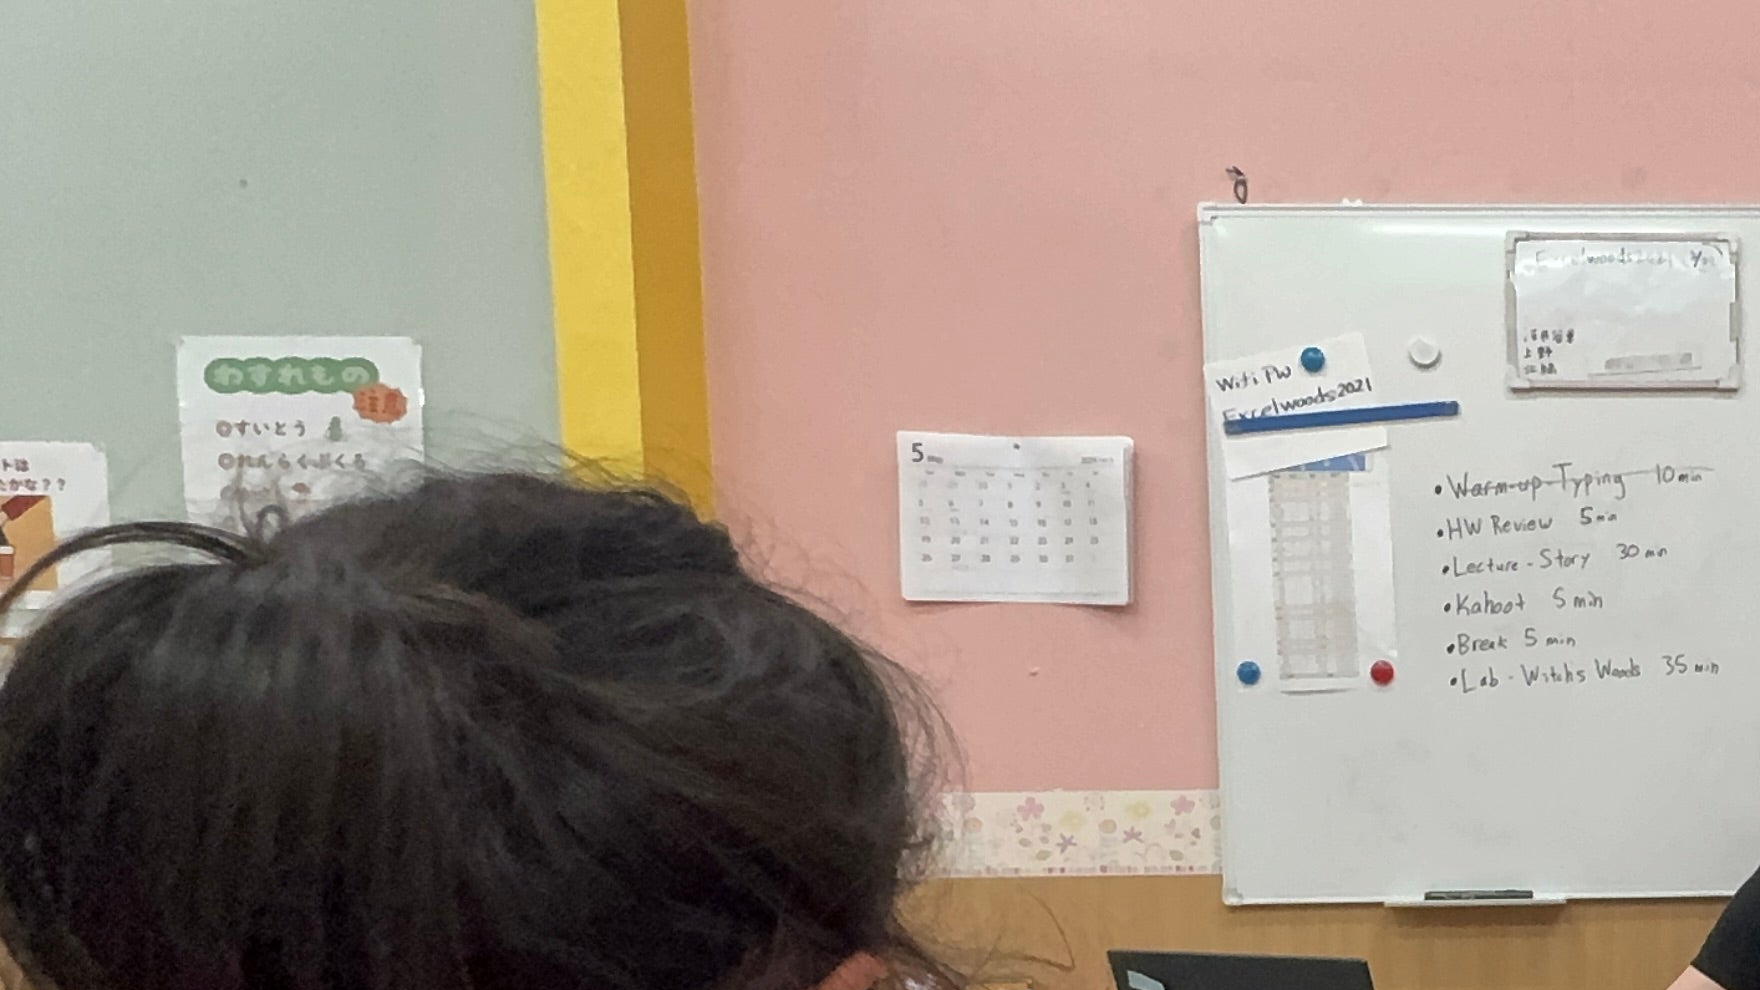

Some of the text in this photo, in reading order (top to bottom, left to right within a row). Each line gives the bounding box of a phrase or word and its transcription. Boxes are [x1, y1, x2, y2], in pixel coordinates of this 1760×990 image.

[213, 362, 371, 386] わすれもの
[235, 419, 306, 437] すいとう
[911, 443, 925, 463] 5
[1447, 472, 1542, 501] Warm-up
[1551, 462, 1627, 500] Typing
[1447, 517, 1482, 540] HW
[1490, 514, 1553, 535] Review
[1453, 555, 1518, 577] Lecture
[1540, 548, 1591, 569] Story
[1456, 591, 1526, 616] Kahoot
[1457, 633, 1508, 655] Break
[1461, 667, 1499, 694] Lab
[1594, 657, 1642, 680] Woods
